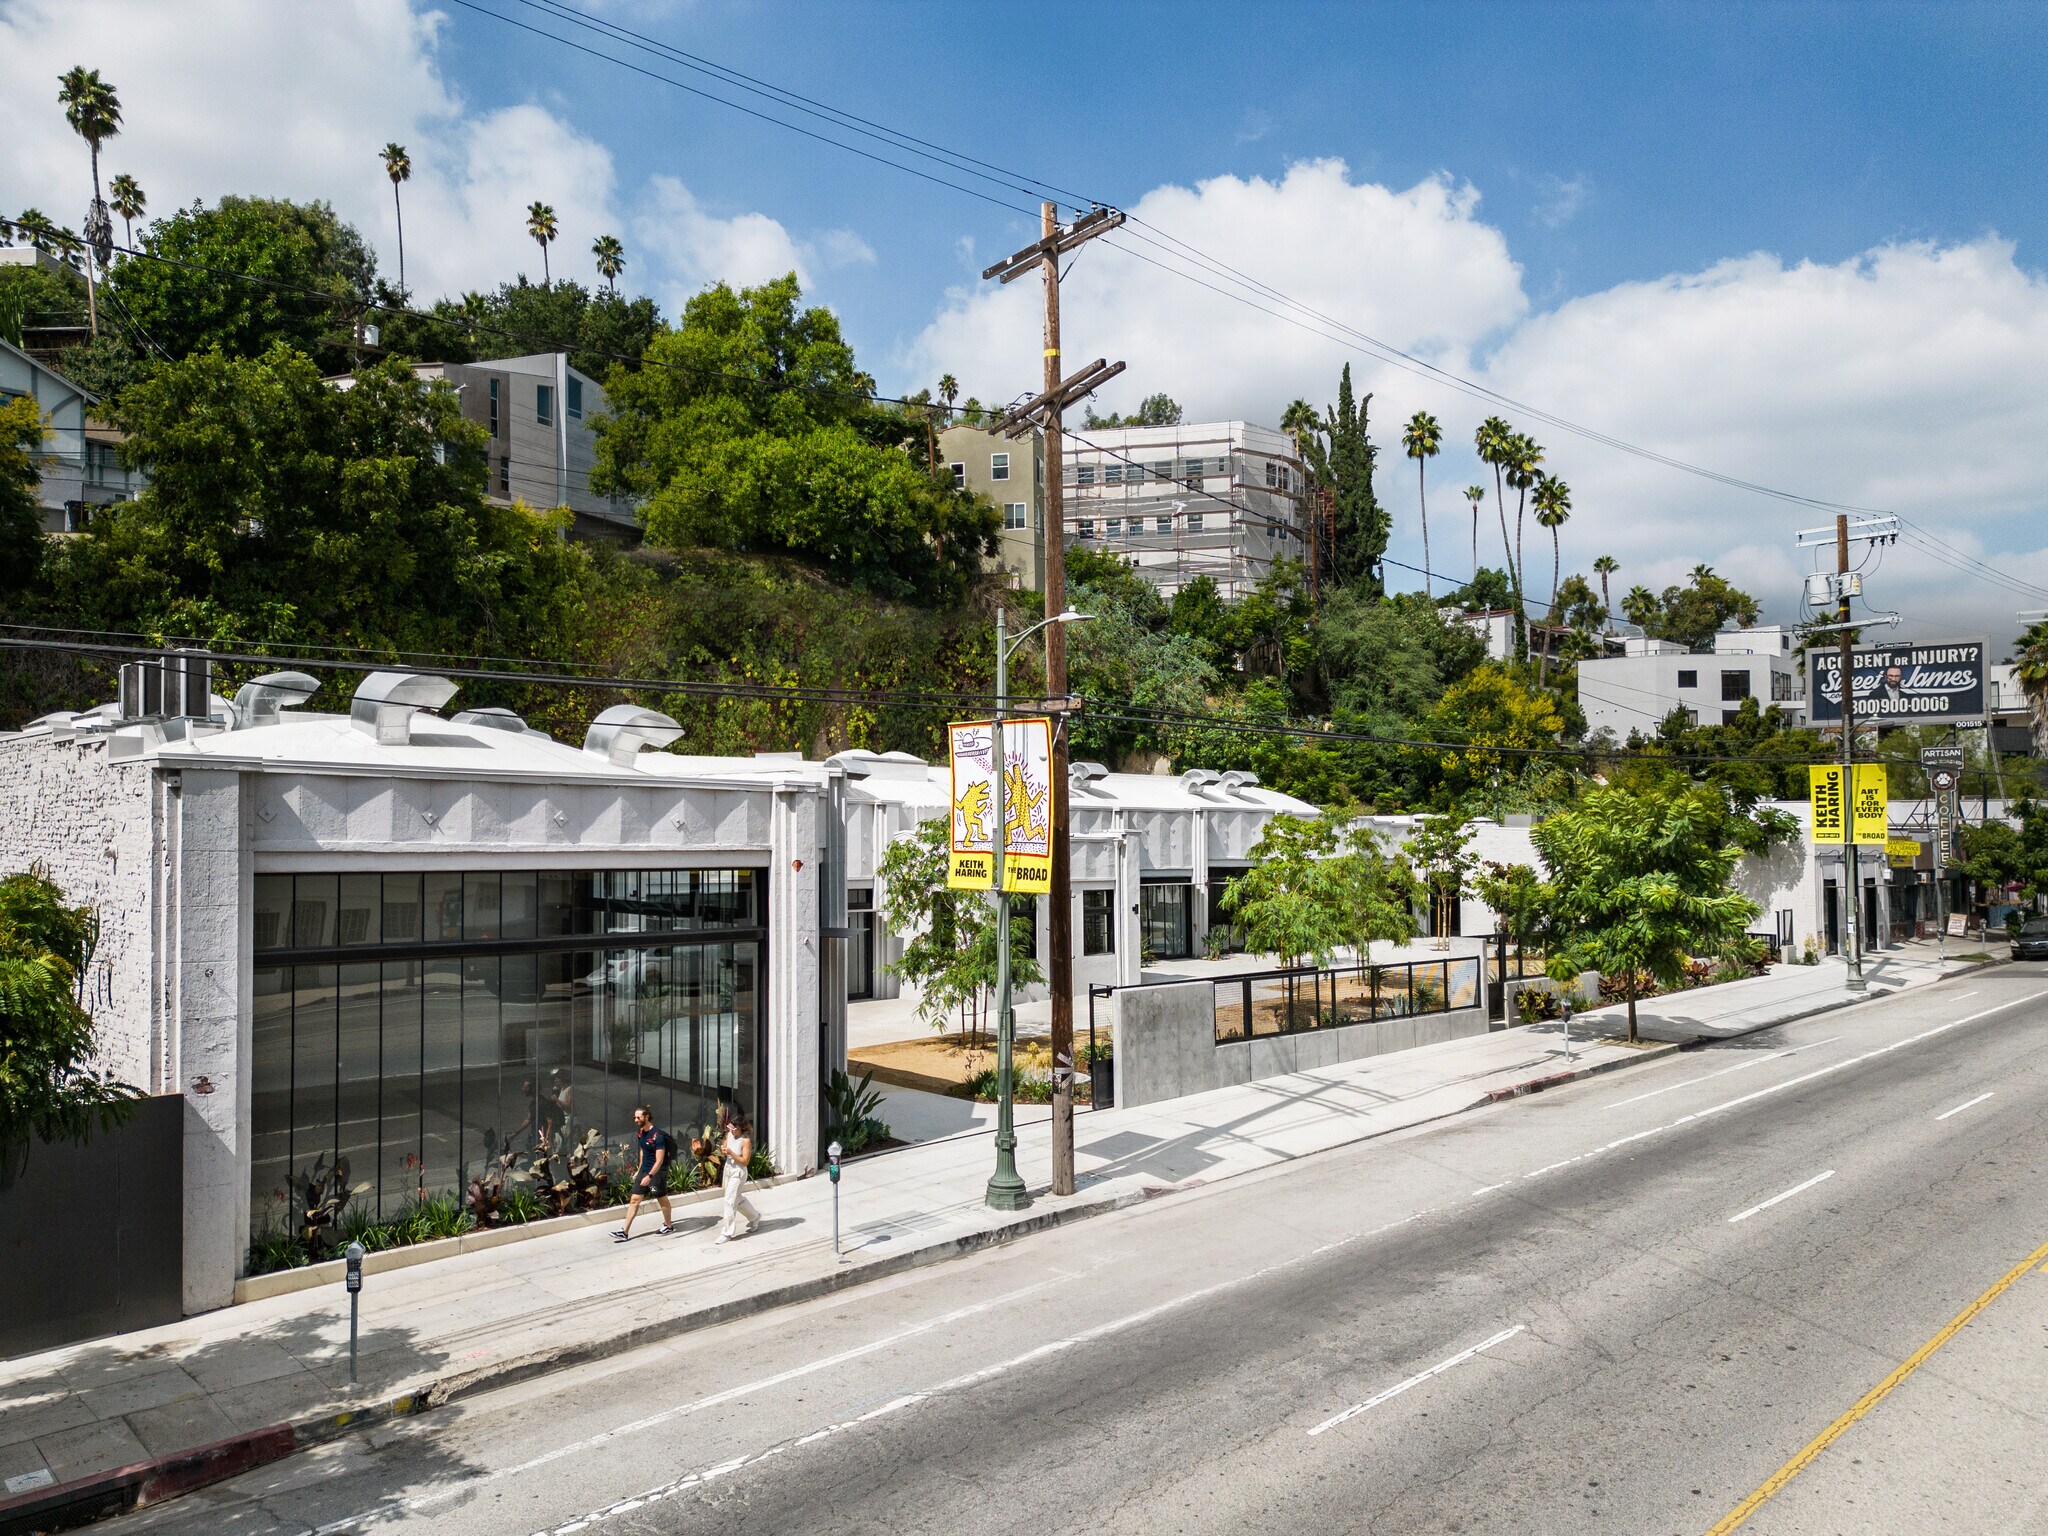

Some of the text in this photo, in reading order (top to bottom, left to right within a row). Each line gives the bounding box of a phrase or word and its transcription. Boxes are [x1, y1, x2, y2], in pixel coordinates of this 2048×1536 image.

[1911, 647, 1979, 666] INJURY?
[1900, 665, 1977, 689] James
[1924, 749, 1961, 758] ARTISAN
[1815, 785, 1827, 828] KEITH
[1827, 771, 1840, 828] HARING
[1939, 794, 1950, 862] COFFEE
[955, 868, 987, 878] HARING
[959, 860, 983, 869] KEITH
[1016, 868, 1047, 881] BROAD
